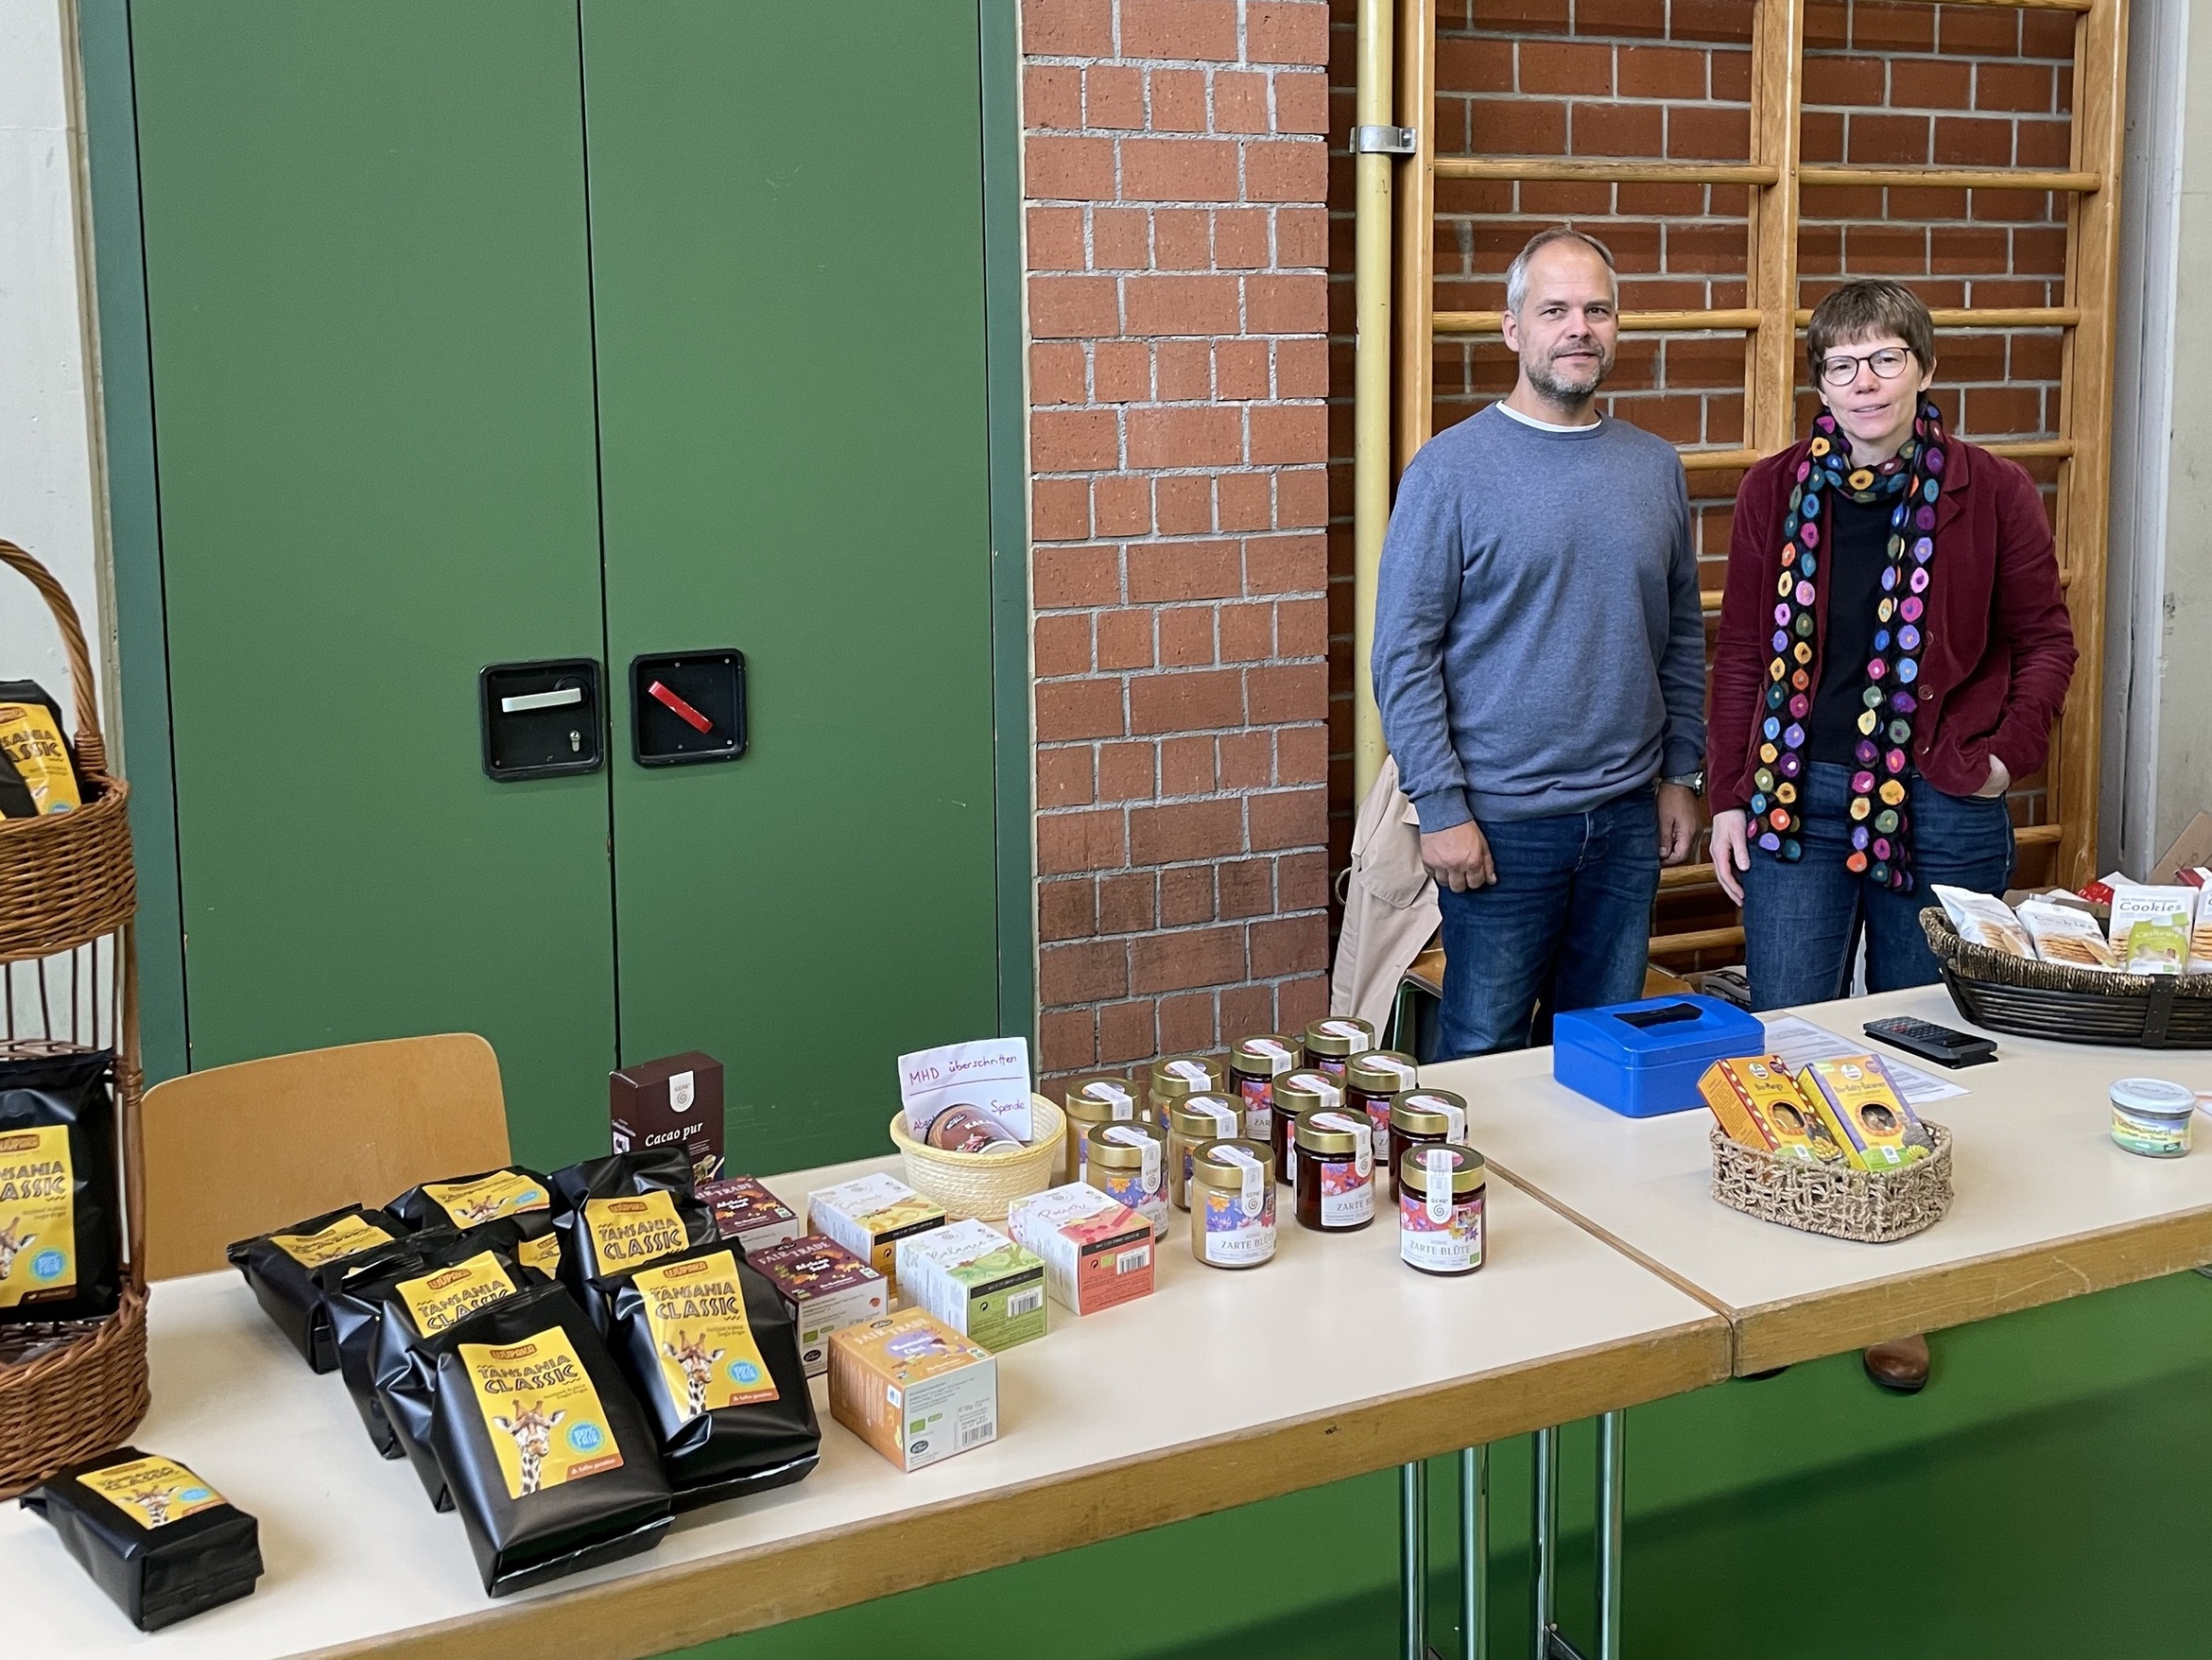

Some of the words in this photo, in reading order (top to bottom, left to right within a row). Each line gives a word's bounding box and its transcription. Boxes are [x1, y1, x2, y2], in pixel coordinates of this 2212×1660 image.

[2119, 902, 2182, 912] Cookies
[909, 1067, 940, 1086] MHD
[949, 1053, 1017, 1074] überschritten
[991, 1099, 1025, 1115] Spende
[645, 1131, 681, 1147] Cacao
[683, 1122, 703, 1140] pur
[1254, 1118, 1270, 1127] ZAR
[1337, 1201, 1364, 1212] ZARTE
[598, 1218, 678, 1242] TANSANIA
[1221, 1240, 1252, 1250] ZARTE
[1254, 1231, 1275, 1247] BLÜT
[604, 1229, 683, 1260] CLASSIC
[1409, 1239, 1437, 1255] ZARTE
[1441, 1243, 1471, 1256] BLÜTE
[418, 1280, 506, 1317] TANSANIA
[650, 1281, 735, 1302] TANSANIA
[655, 1296, 739, 1320] CLASSIC
[478, 1355, 571, 1379] TANSANIA
[484, 1363, 579, 1394] CLASSIC
